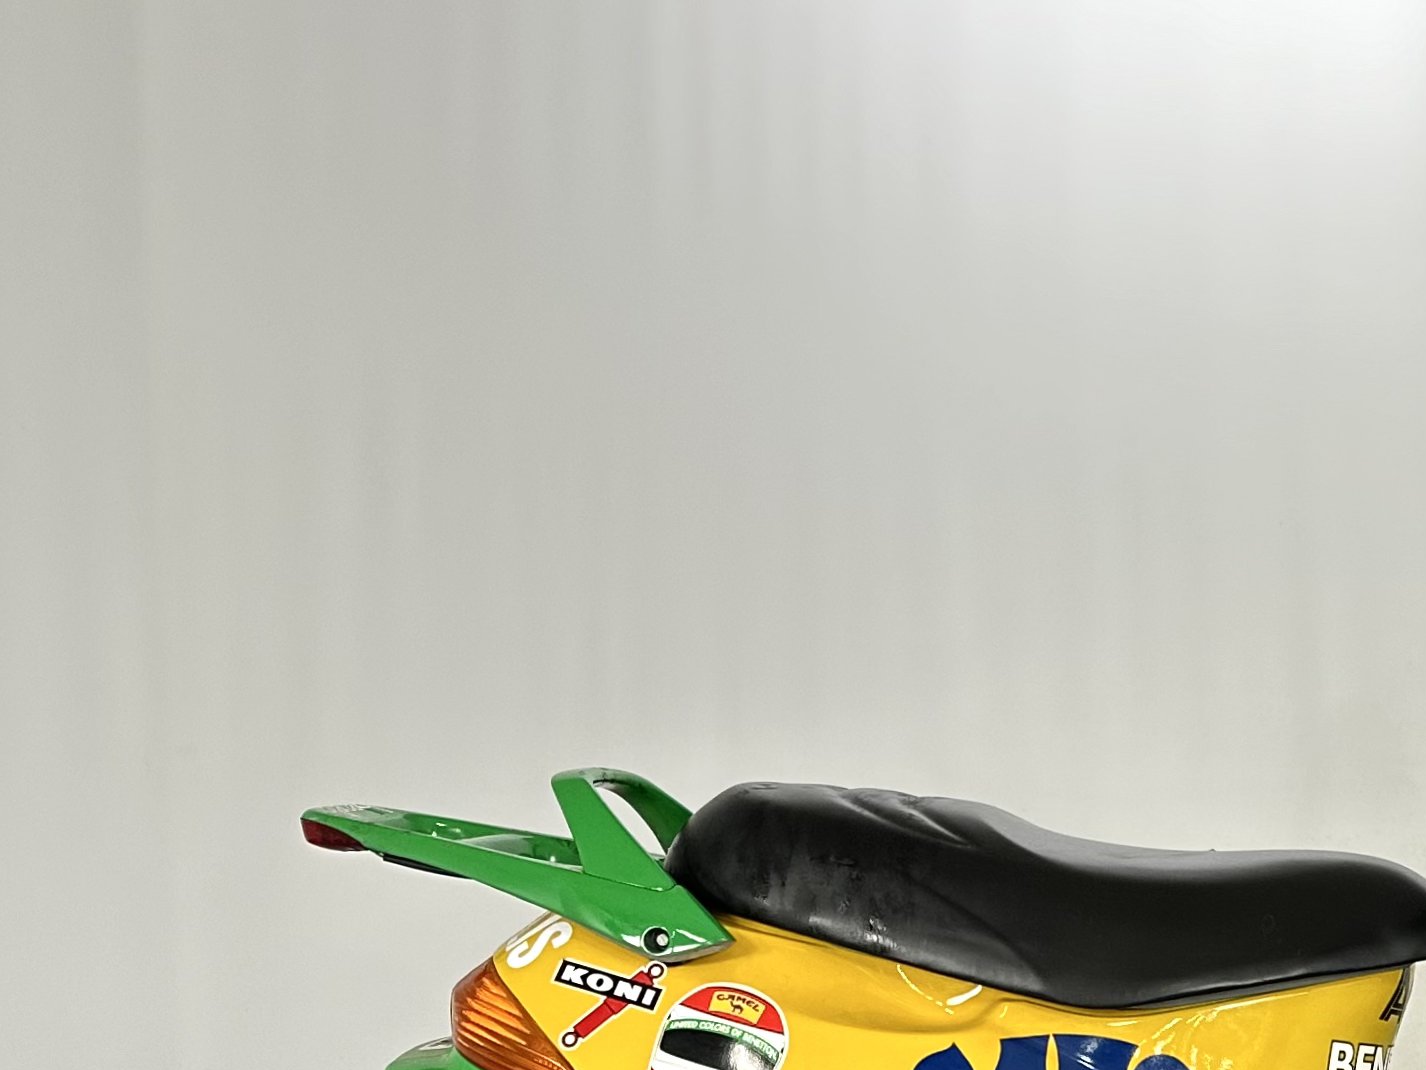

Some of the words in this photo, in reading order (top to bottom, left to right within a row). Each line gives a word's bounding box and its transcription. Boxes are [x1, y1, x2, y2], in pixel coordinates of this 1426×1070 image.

[560, 964, 657, 1007] KONI
[716, 993, 760, 1013] CAMEL
[699, 1021, 731, 1034] COLORS
